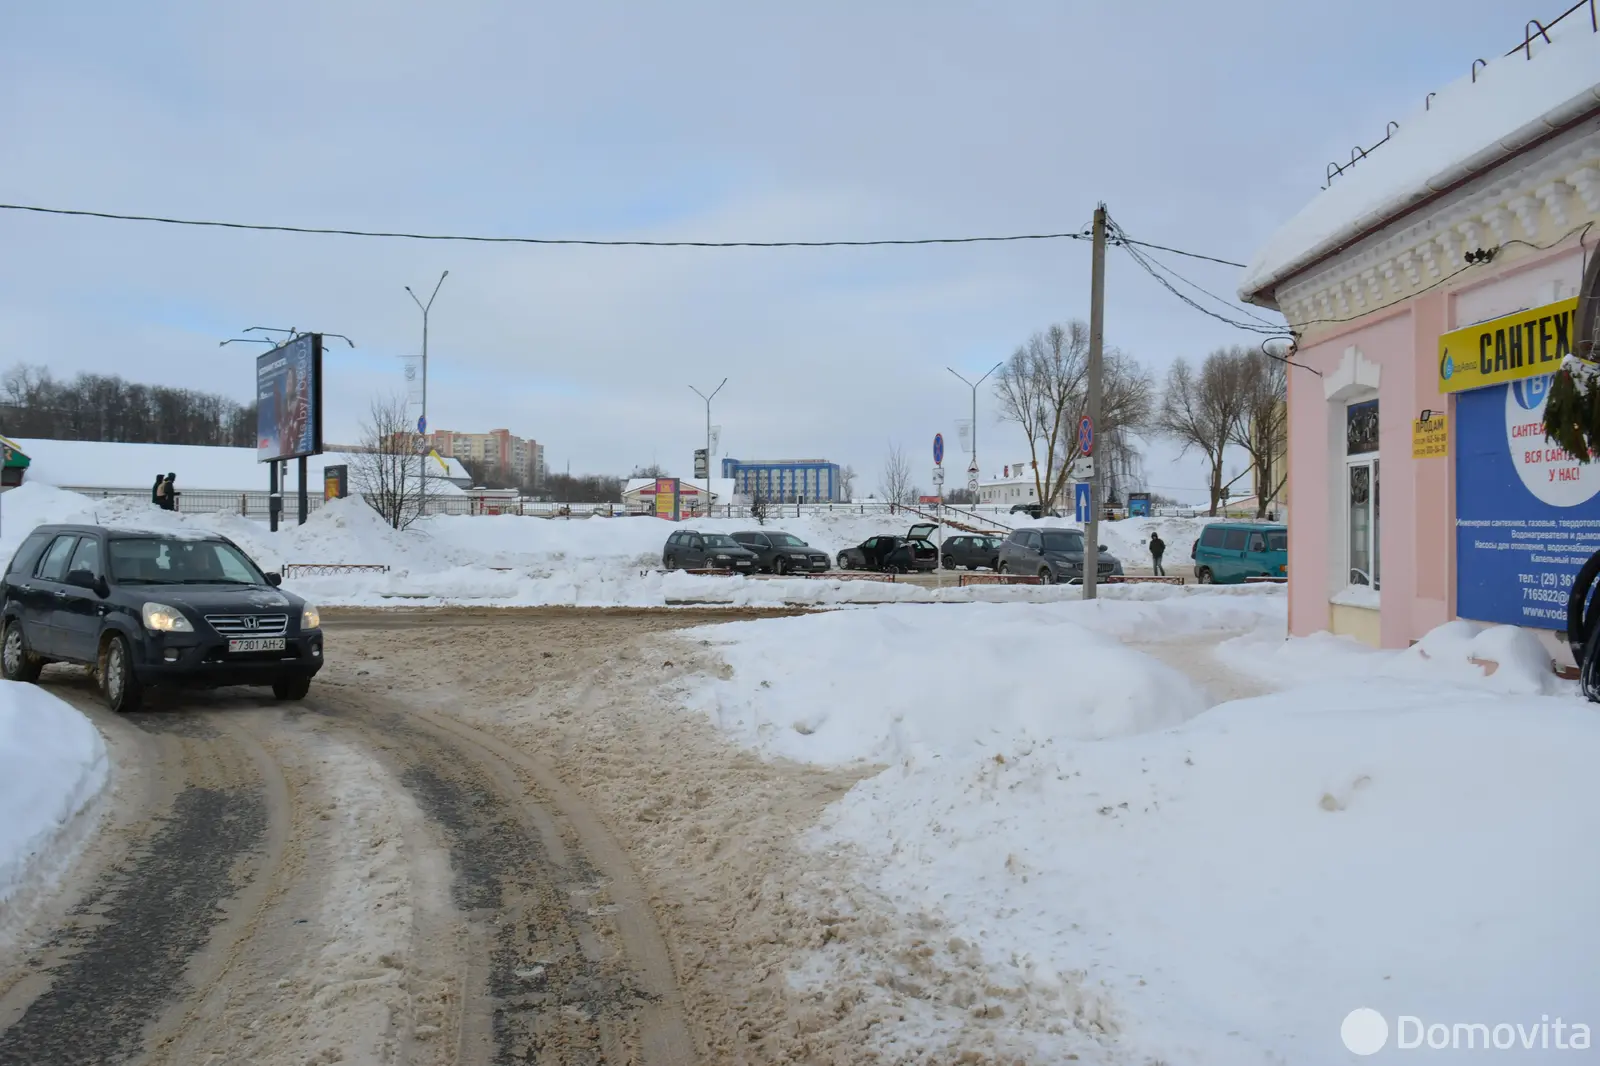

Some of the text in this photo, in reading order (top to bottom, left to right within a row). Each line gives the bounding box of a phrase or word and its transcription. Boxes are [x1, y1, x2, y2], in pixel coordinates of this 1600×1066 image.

[1479, 309, 1576, 375] САНТЕХ
[1415, 419, 1443, 434] ПРОДАМ
[1512, 423, 1546, 438] САНТЕХ
[1525, 451, 1541, 463] ВСЯ
[1549, 467, 1580, 482] У НАС!
[1528, 520, 1557, 528] газовые,
[1512, 530, 1568, 540] Водонагреватели
[1475, 540, 1497, 549] Насосы
[1498, 543, 1509, 551] для
[1531, 553, 1569, 564] Капельный
[1541, 573, 1557, 588] (29)
[1560, 574, 1576, 587] 361
[1522, 588, 1570, 606] 7165822@
[1522, 606, 1568, 621] www.voda
[238, 639, 284, 650] 7301 AH-2
